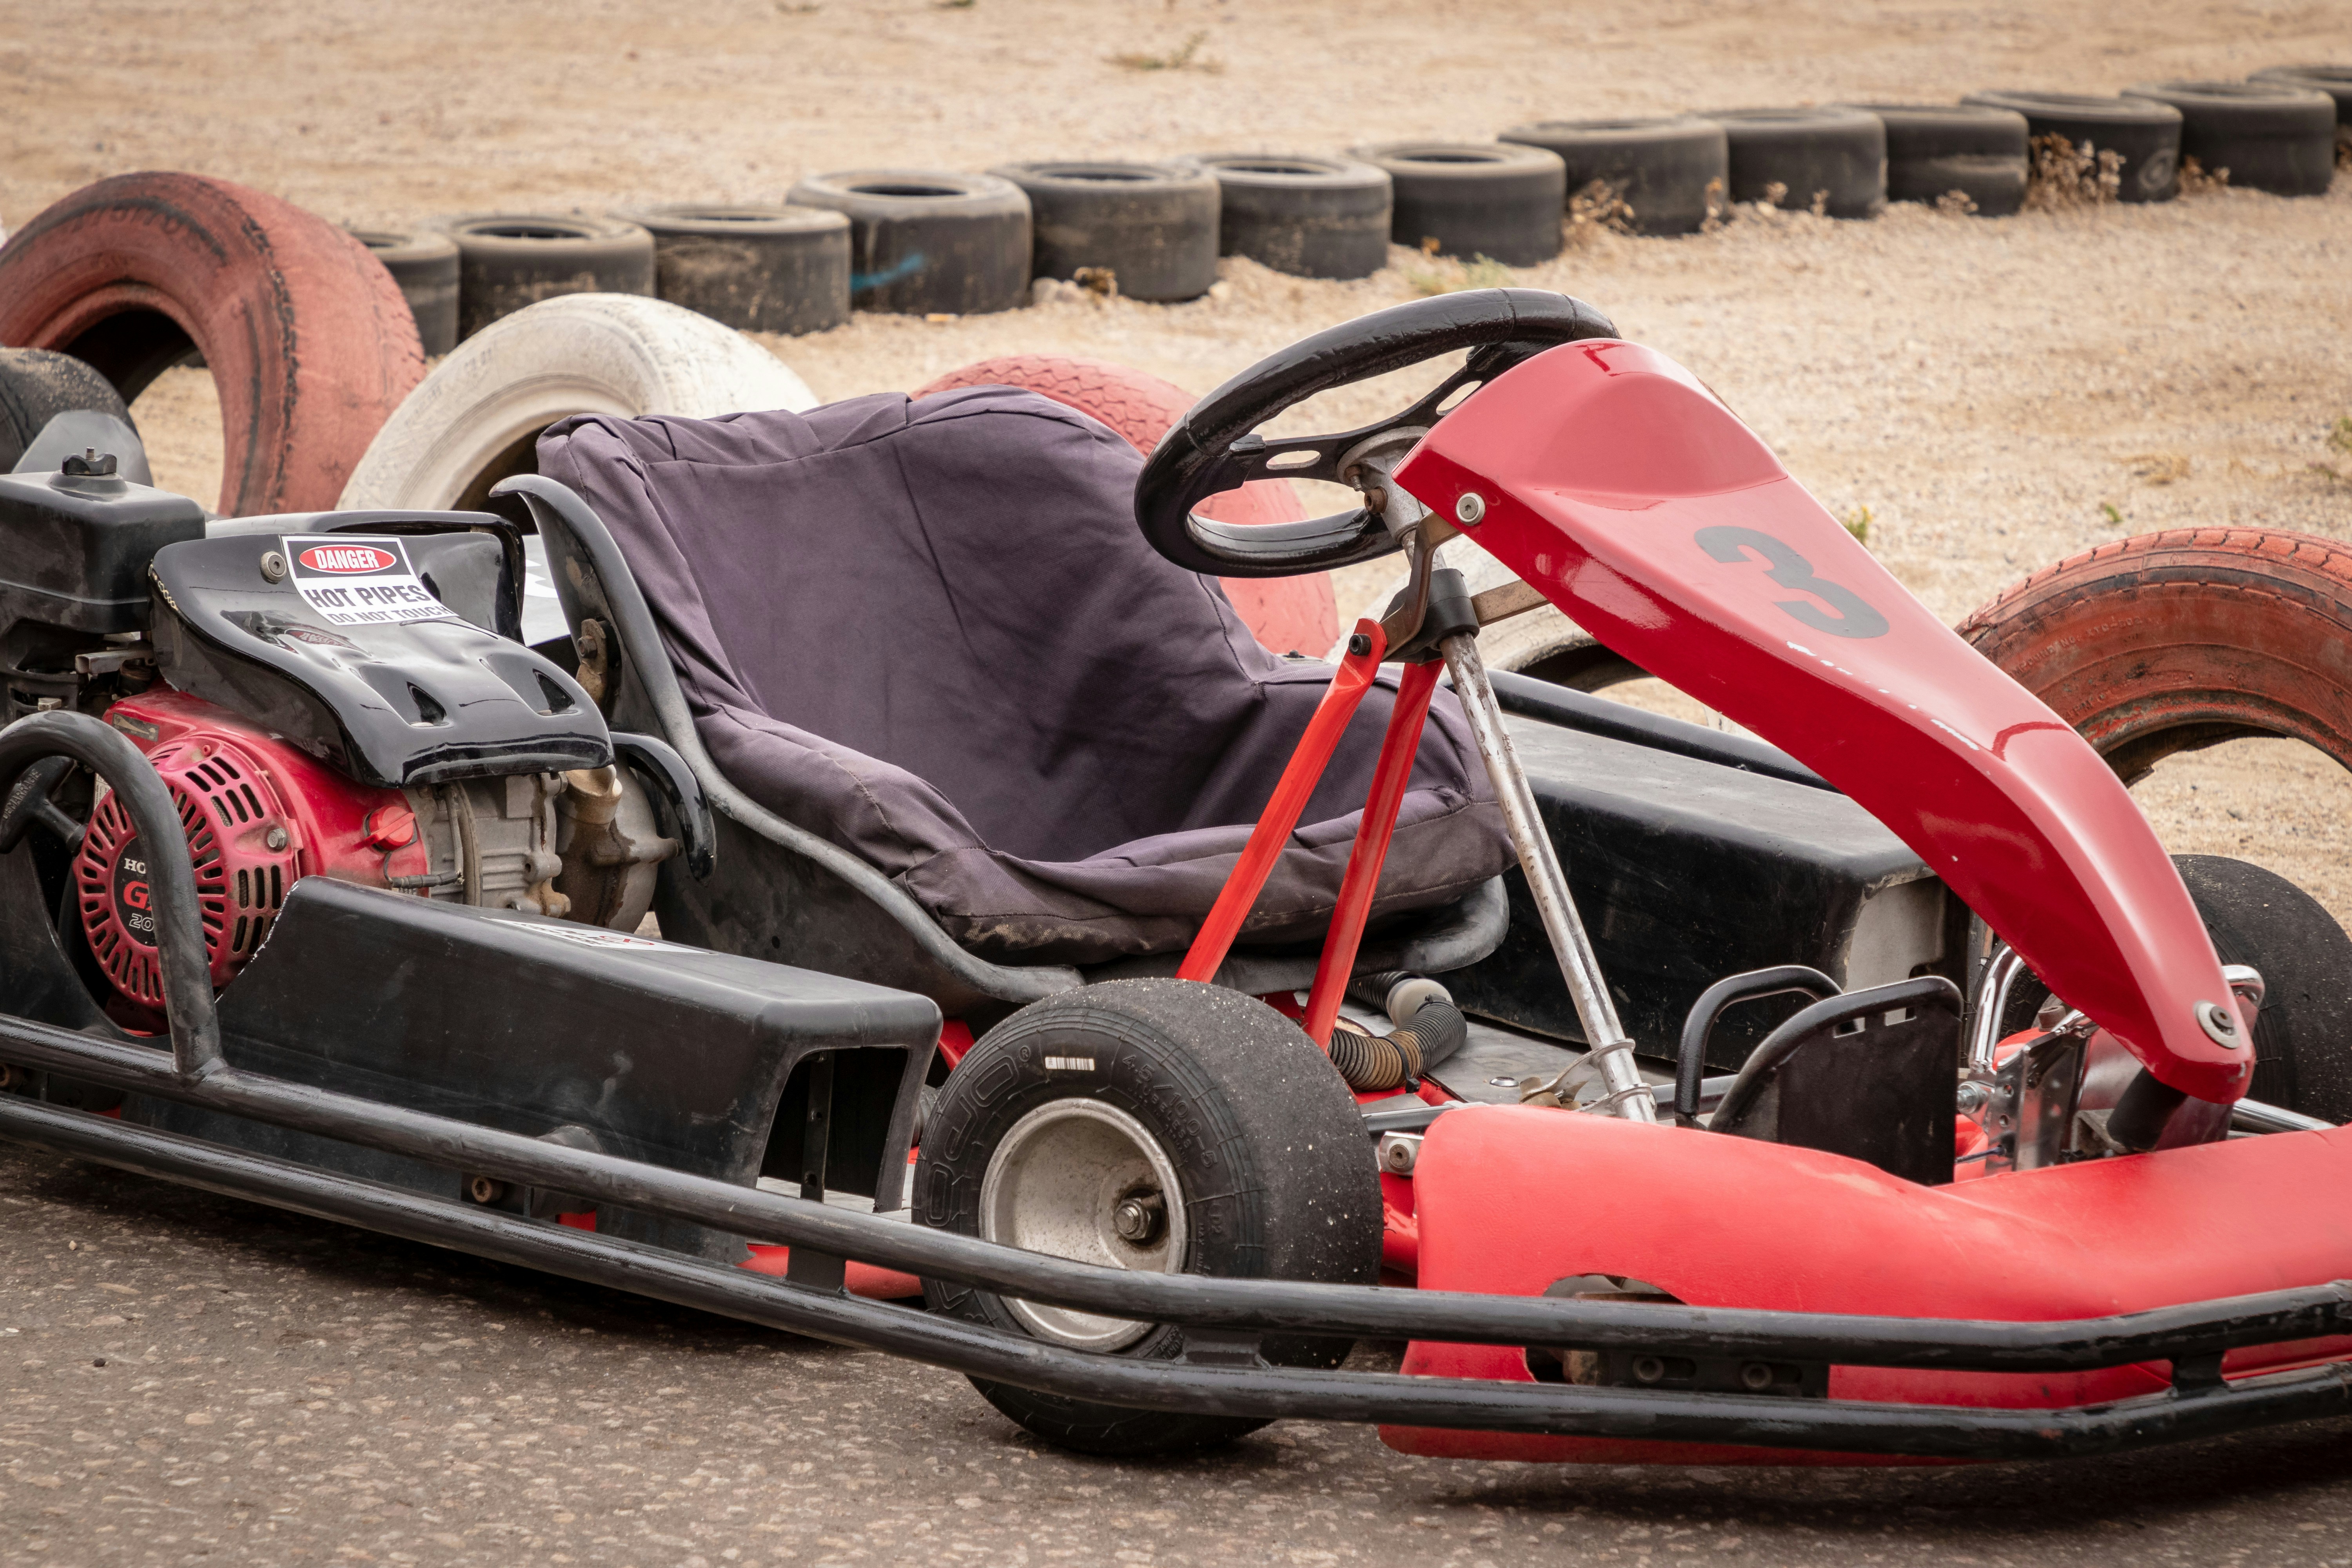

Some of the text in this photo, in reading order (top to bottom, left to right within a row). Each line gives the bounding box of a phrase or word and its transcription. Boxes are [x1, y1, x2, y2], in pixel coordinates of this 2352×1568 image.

[314, 550, 380, 569] DANGER
[1694, 526, 1889, 639] 3
[303, 585, 431, 608] HOT PIPES
[327, 606, 454, 623] DO NOT TOUCH
[124, 858, 146, 874] HO
[123, 880, 152, 911] G
[129, 913, 154, 932] 20
